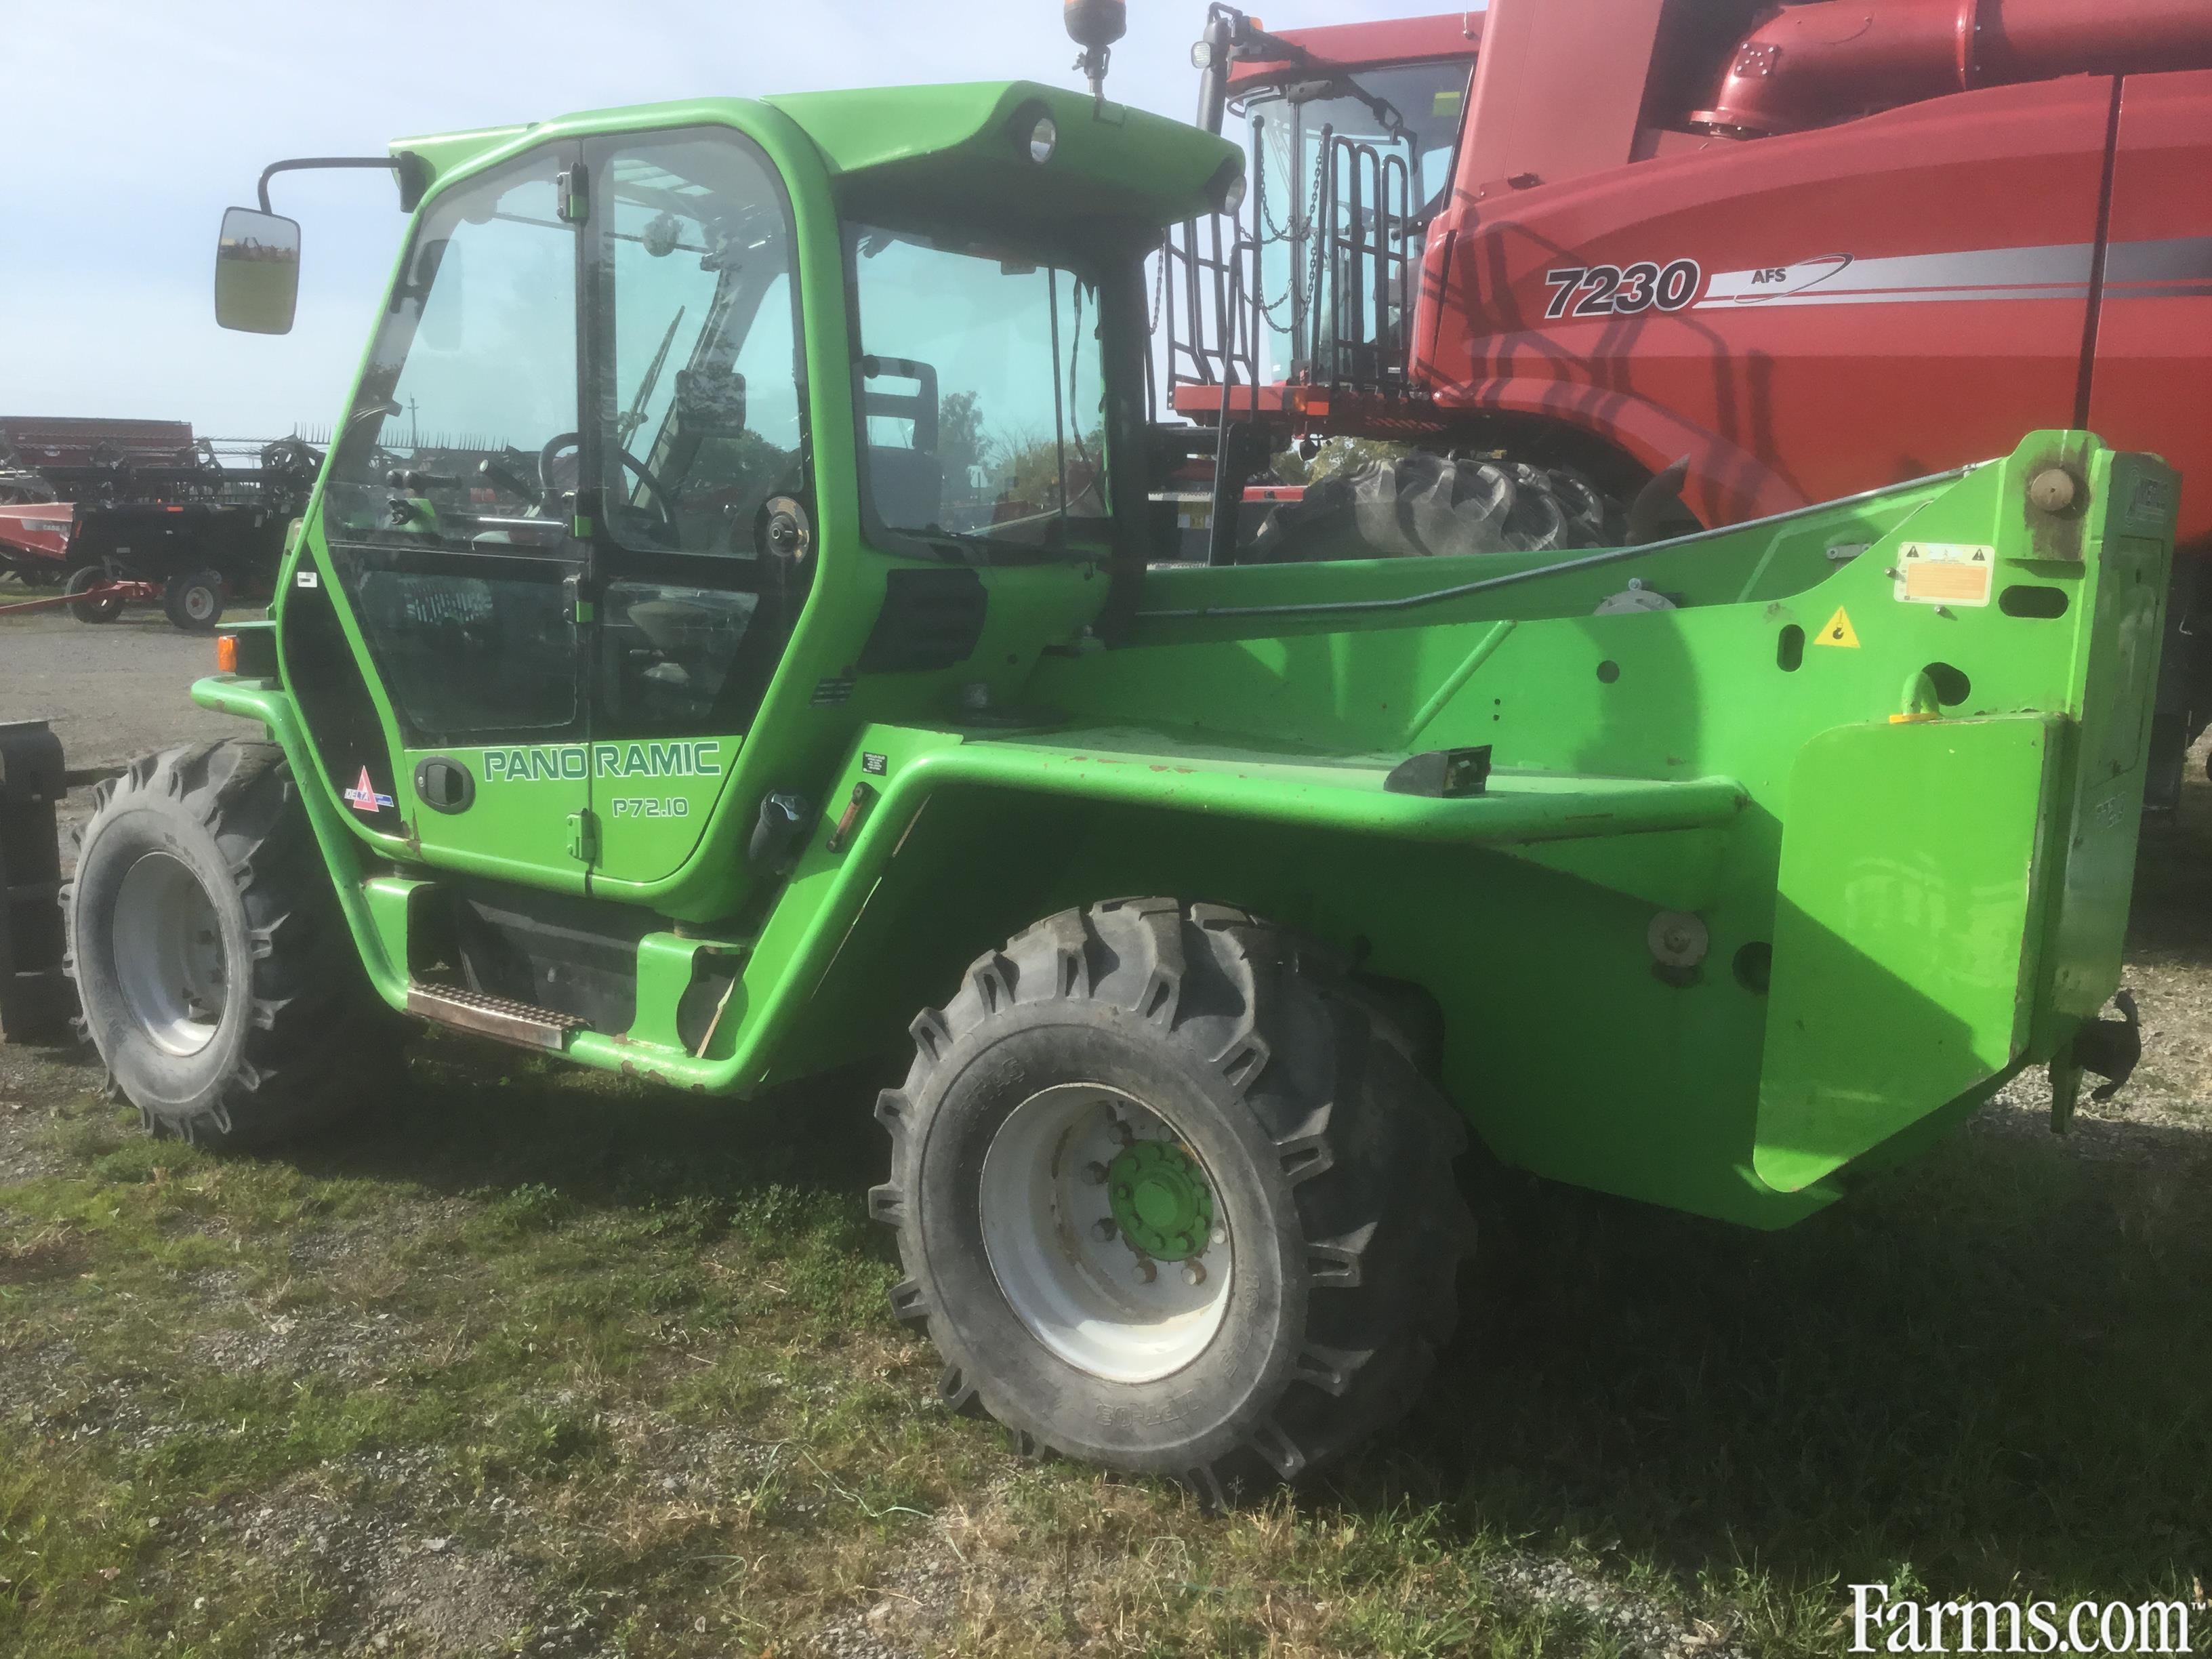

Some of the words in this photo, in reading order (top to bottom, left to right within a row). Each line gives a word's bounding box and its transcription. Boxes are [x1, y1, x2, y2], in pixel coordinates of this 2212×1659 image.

[1544, 258, 1701, 319] 7230
[1751, 268, 1787, 285] AFS
[483, 741, 721, 781] PANORAMIC
[612, 798, 689, 817] P72.10
